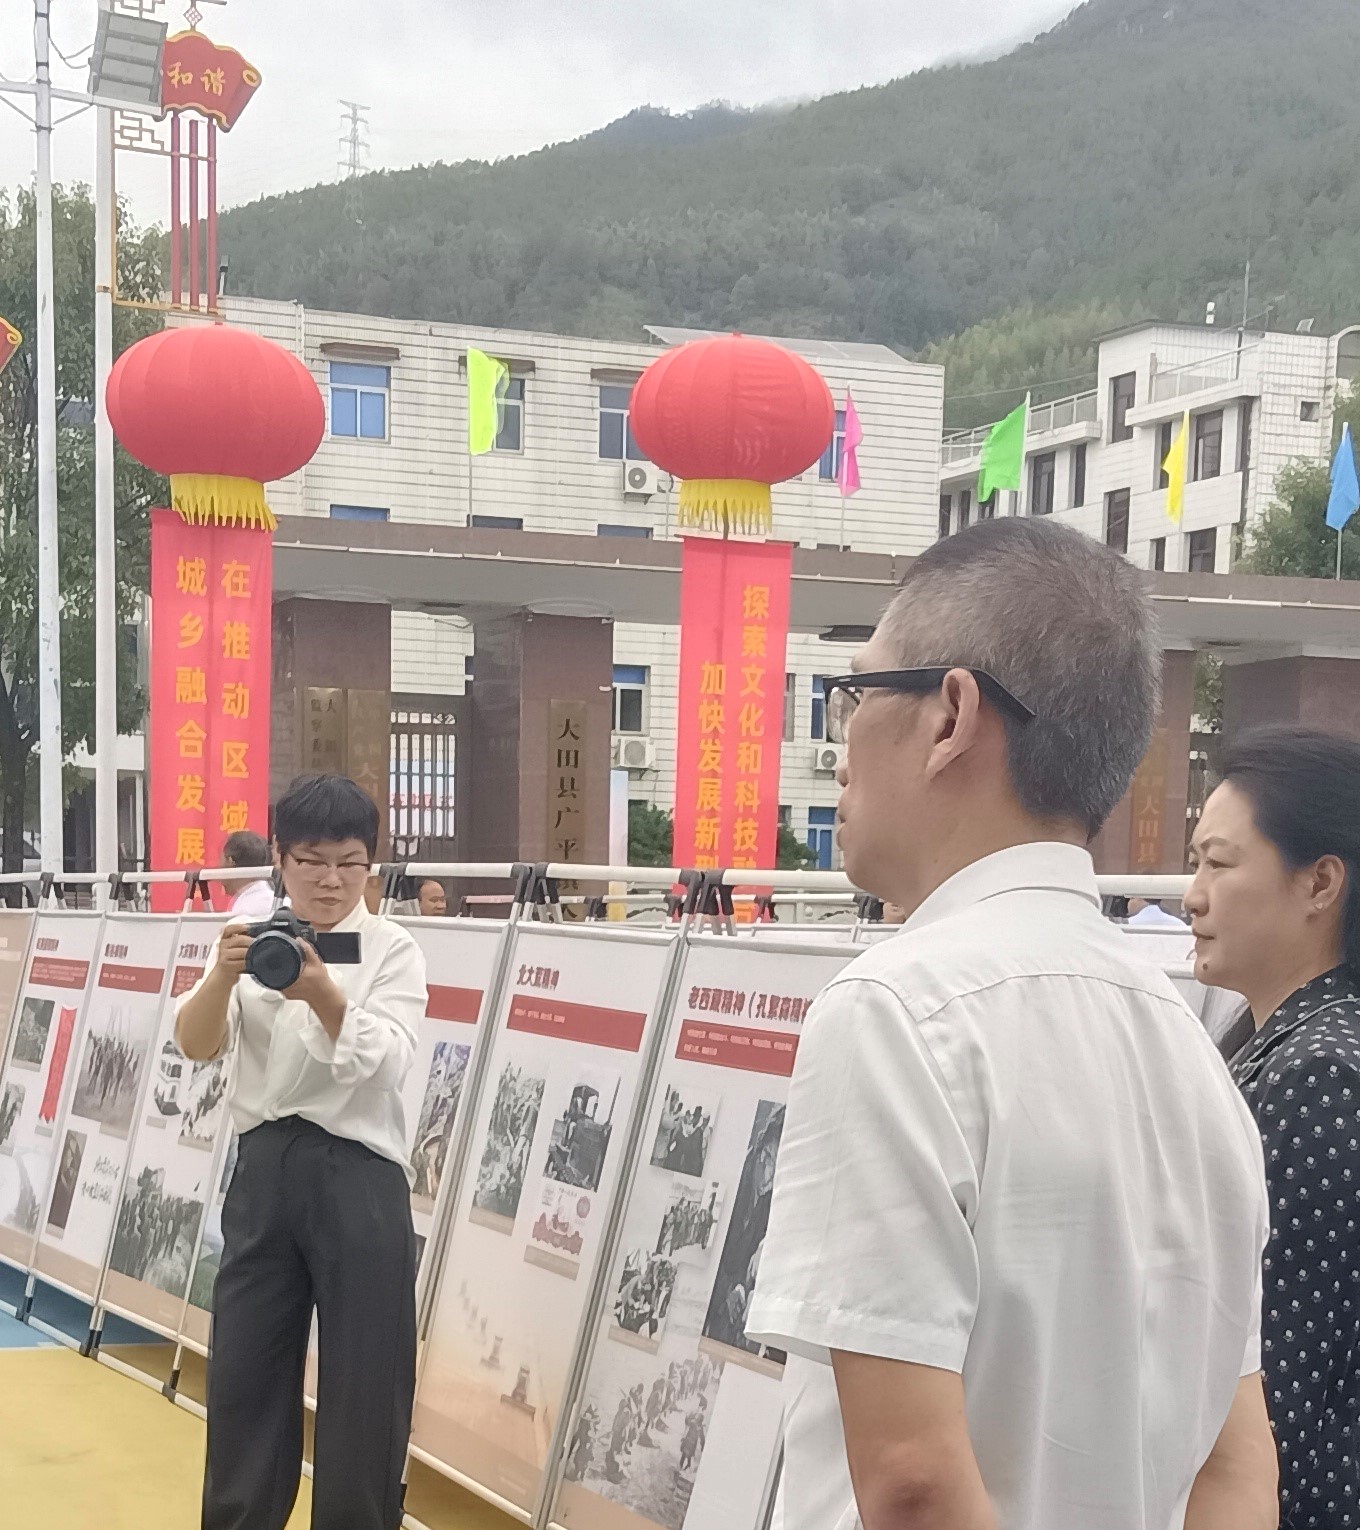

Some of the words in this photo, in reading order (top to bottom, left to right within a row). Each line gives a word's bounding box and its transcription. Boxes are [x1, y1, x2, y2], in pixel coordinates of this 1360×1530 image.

[166, 61, 227, 97] 和谐
[175, 556, 208, 866] 城乡融合发展
[220, 559, 252, 834] 在推动区域
